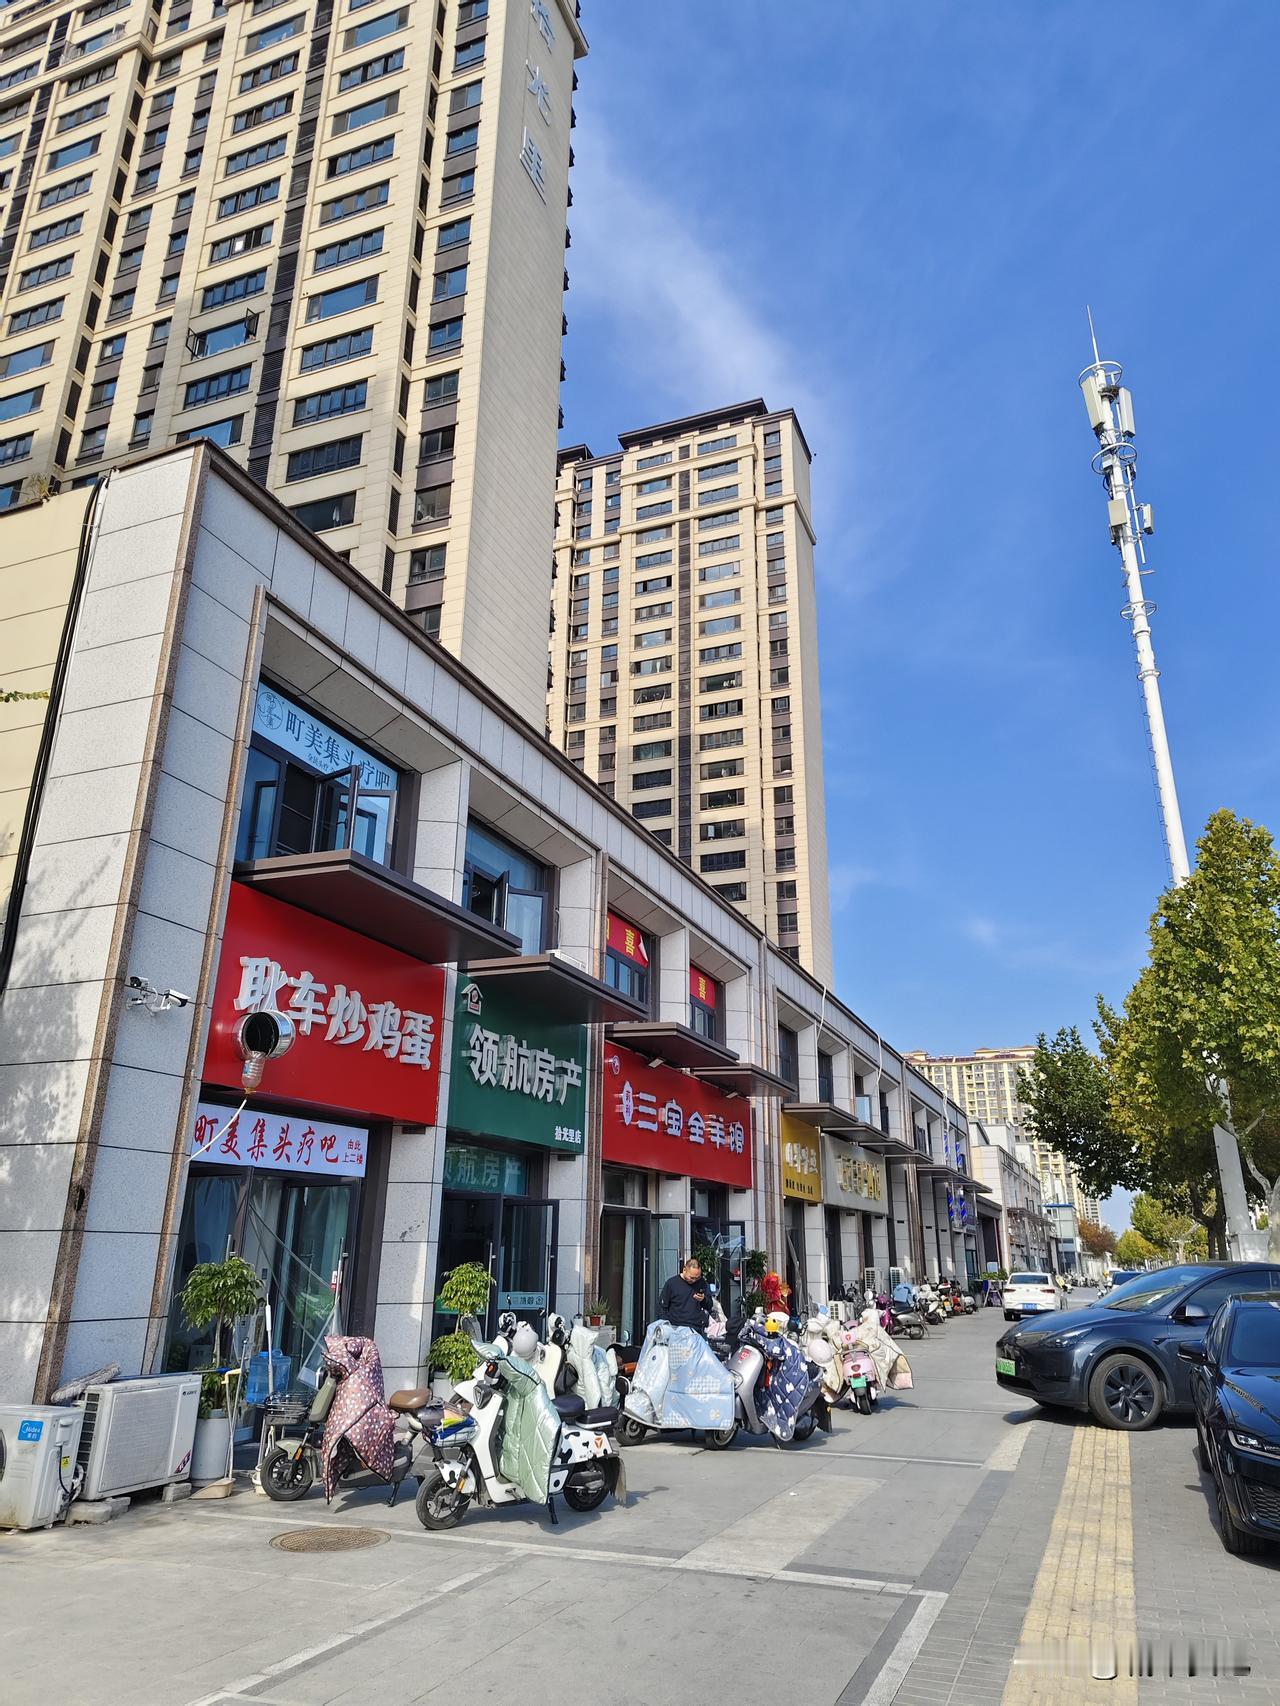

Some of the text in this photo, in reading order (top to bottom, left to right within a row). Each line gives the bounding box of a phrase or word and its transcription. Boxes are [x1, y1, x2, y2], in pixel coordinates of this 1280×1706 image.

[233, 956, 435, 1071] 耿车炒鸡蛋
[468, 1023, 583, 1106] 领航房产
